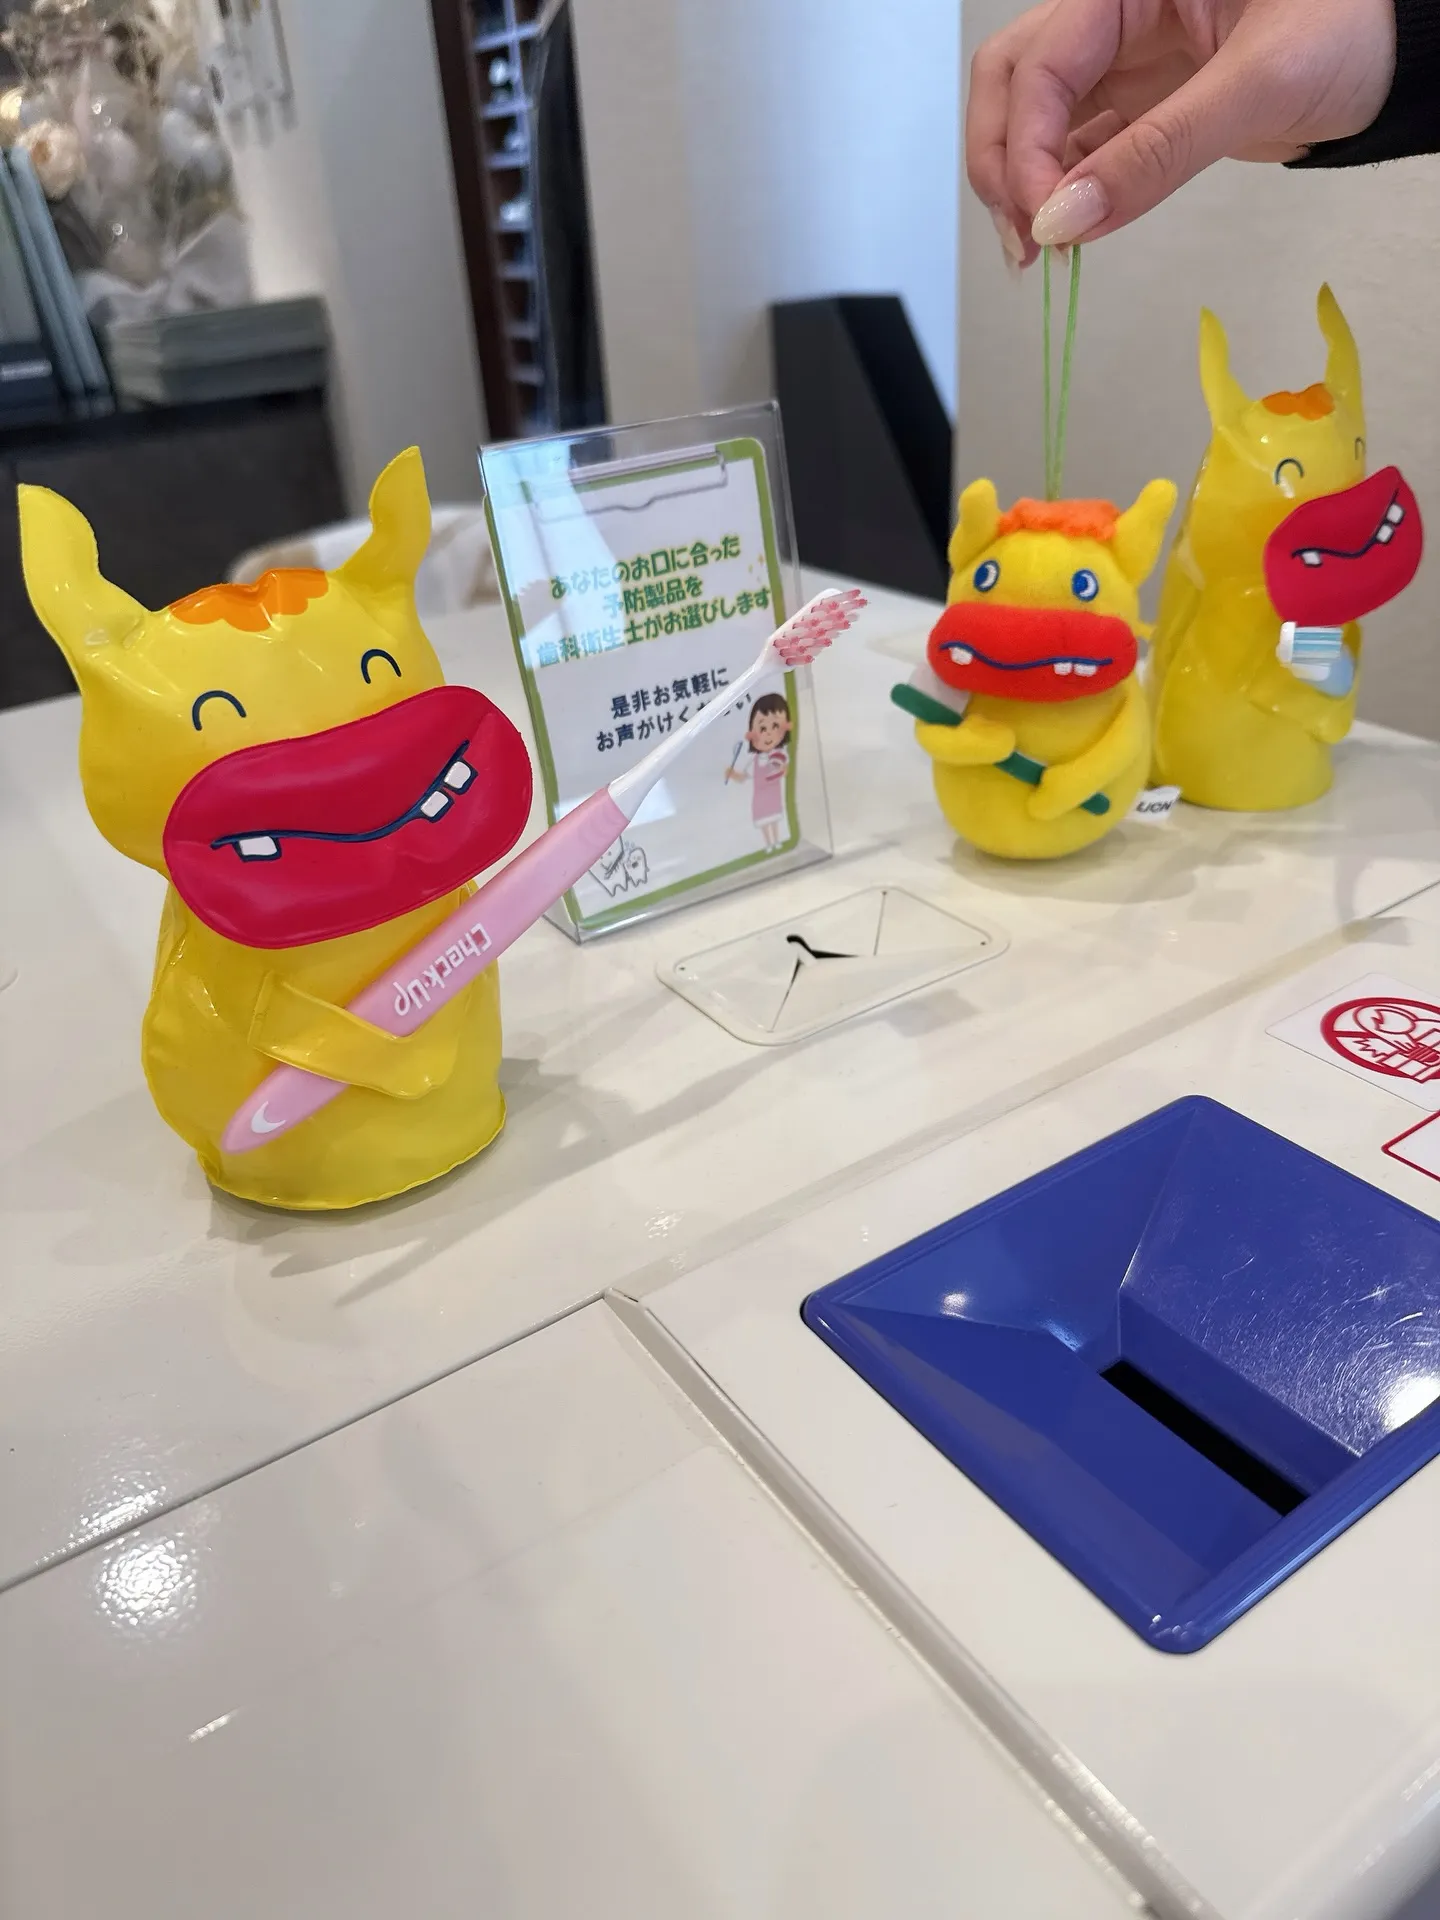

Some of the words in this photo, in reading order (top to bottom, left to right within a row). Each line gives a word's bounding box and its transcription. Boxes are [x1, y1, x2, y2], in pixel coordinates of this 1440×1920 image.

[551, 535, 741, 600] あなたのお口に合った
[603, 575, 703, 619] 予防製品を
[537, 586, 772, 668] 歯科衛生士がお選びします
[596, 693, 752, 752] お声がけくい
[610, 667, 730, 720] 是非お気軽に
